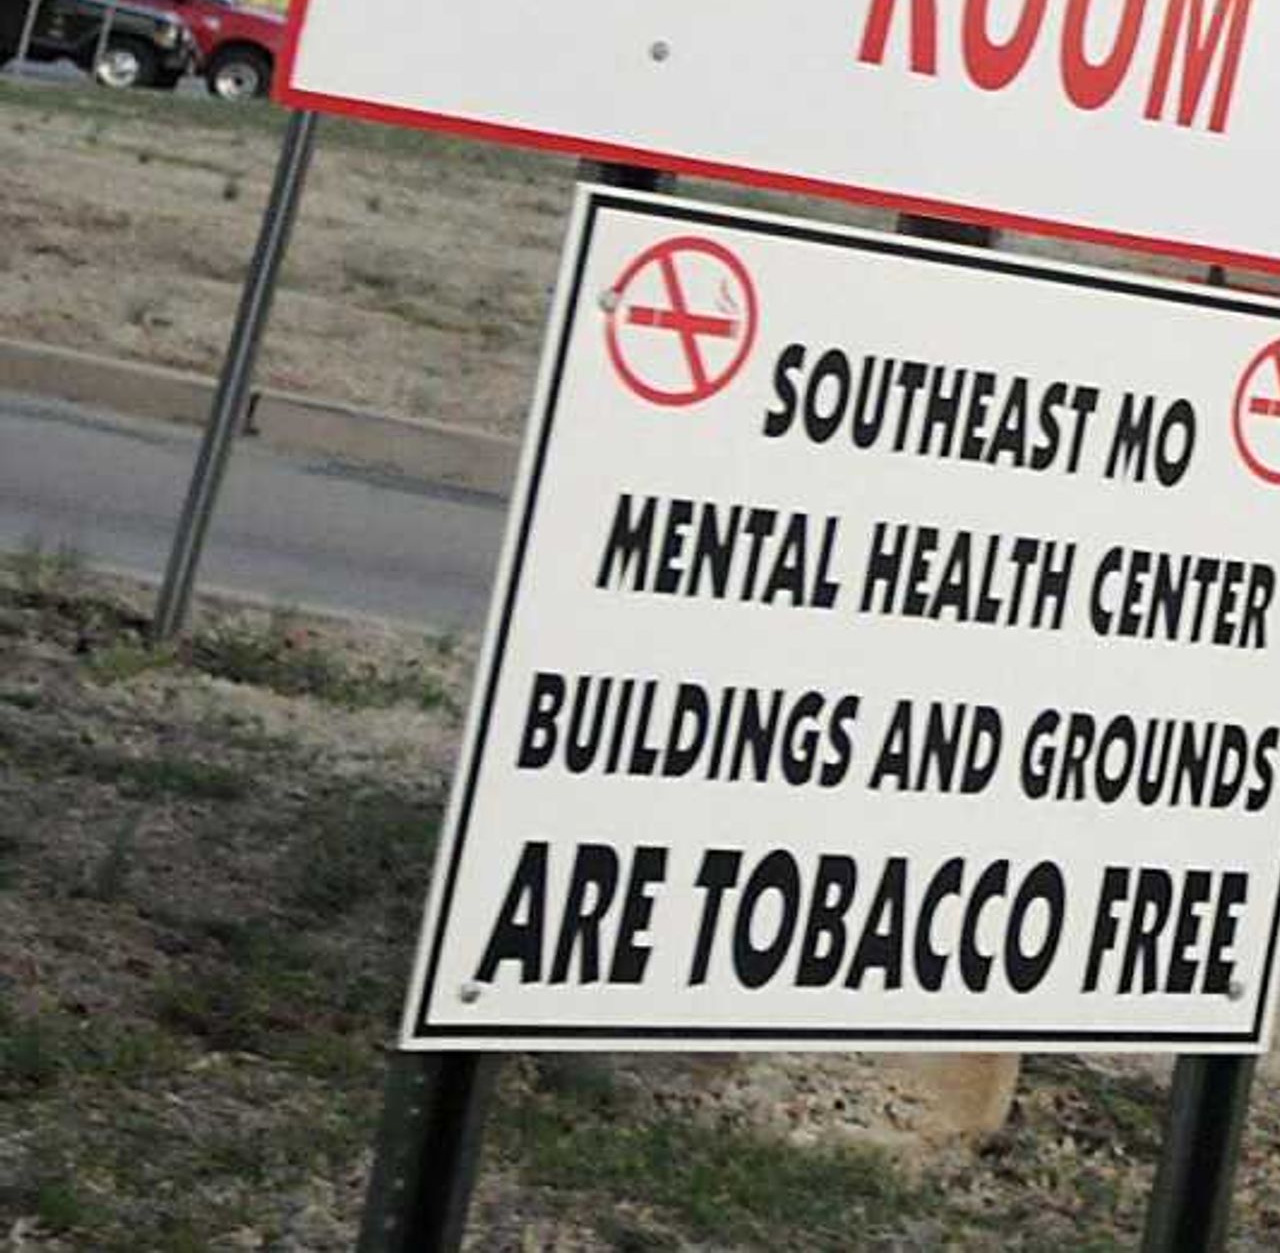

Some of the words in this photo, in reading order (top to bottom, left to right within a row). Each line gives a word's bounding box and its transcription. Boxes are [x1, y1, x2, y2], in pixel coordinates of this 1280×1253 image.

[763, 343, 1099, 474] SOUTHEAST
[1104, 392, 1196, 487] MO
[597, 494, 840, 609] MENTAL
[861, 522, 1077, 630] HEALTH
[1090, 547, 1276, 649] CENTER
[516, 672, 860, 788] BUILDINGS
[868, 700, 1003, 794] AND
[1020, 710, 1280, 812] GROUNDS
[473, 841, 669, 986] ARE
[688, 848, 1066, 994] TOBACCO
[1081, 866, 1249, 996] FREE
